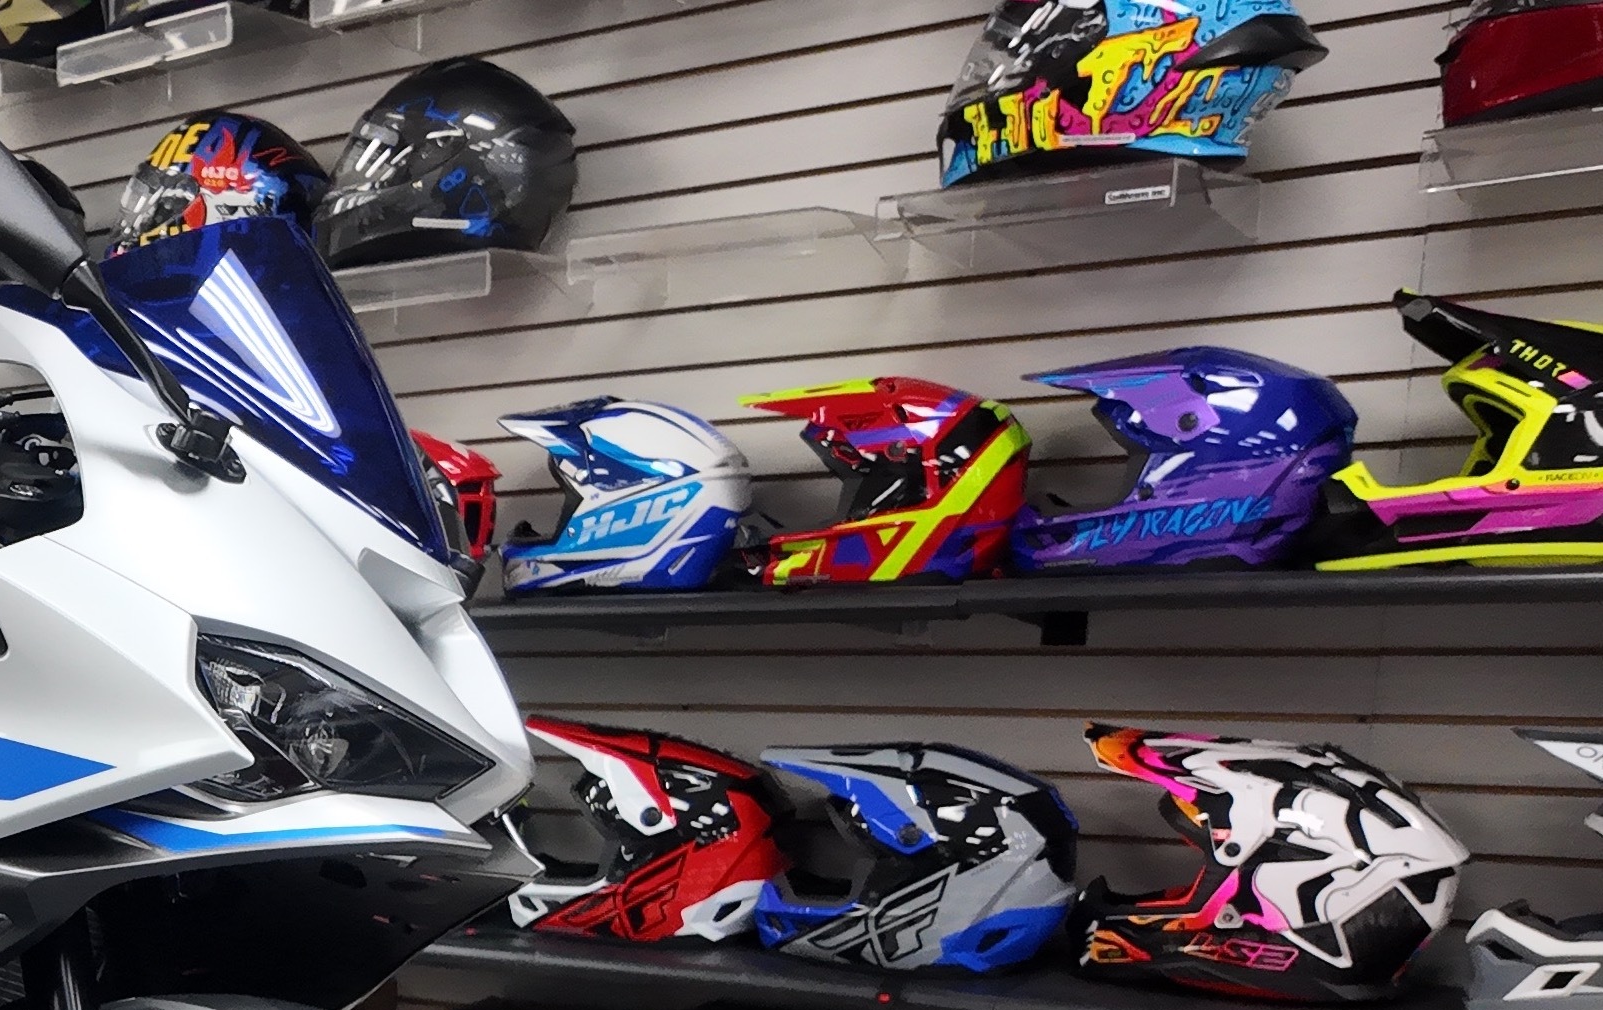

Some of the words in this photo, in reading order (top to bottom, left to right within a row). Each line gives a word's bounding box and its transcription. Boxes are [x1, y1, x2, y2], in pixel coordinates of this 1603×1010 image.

[201, 166, 240, 181] HJC
[576, 487, 691, 545] HJC
[1071, 509, 1139, 552] FLY
[1139, 495, 1276, 541] RACING
